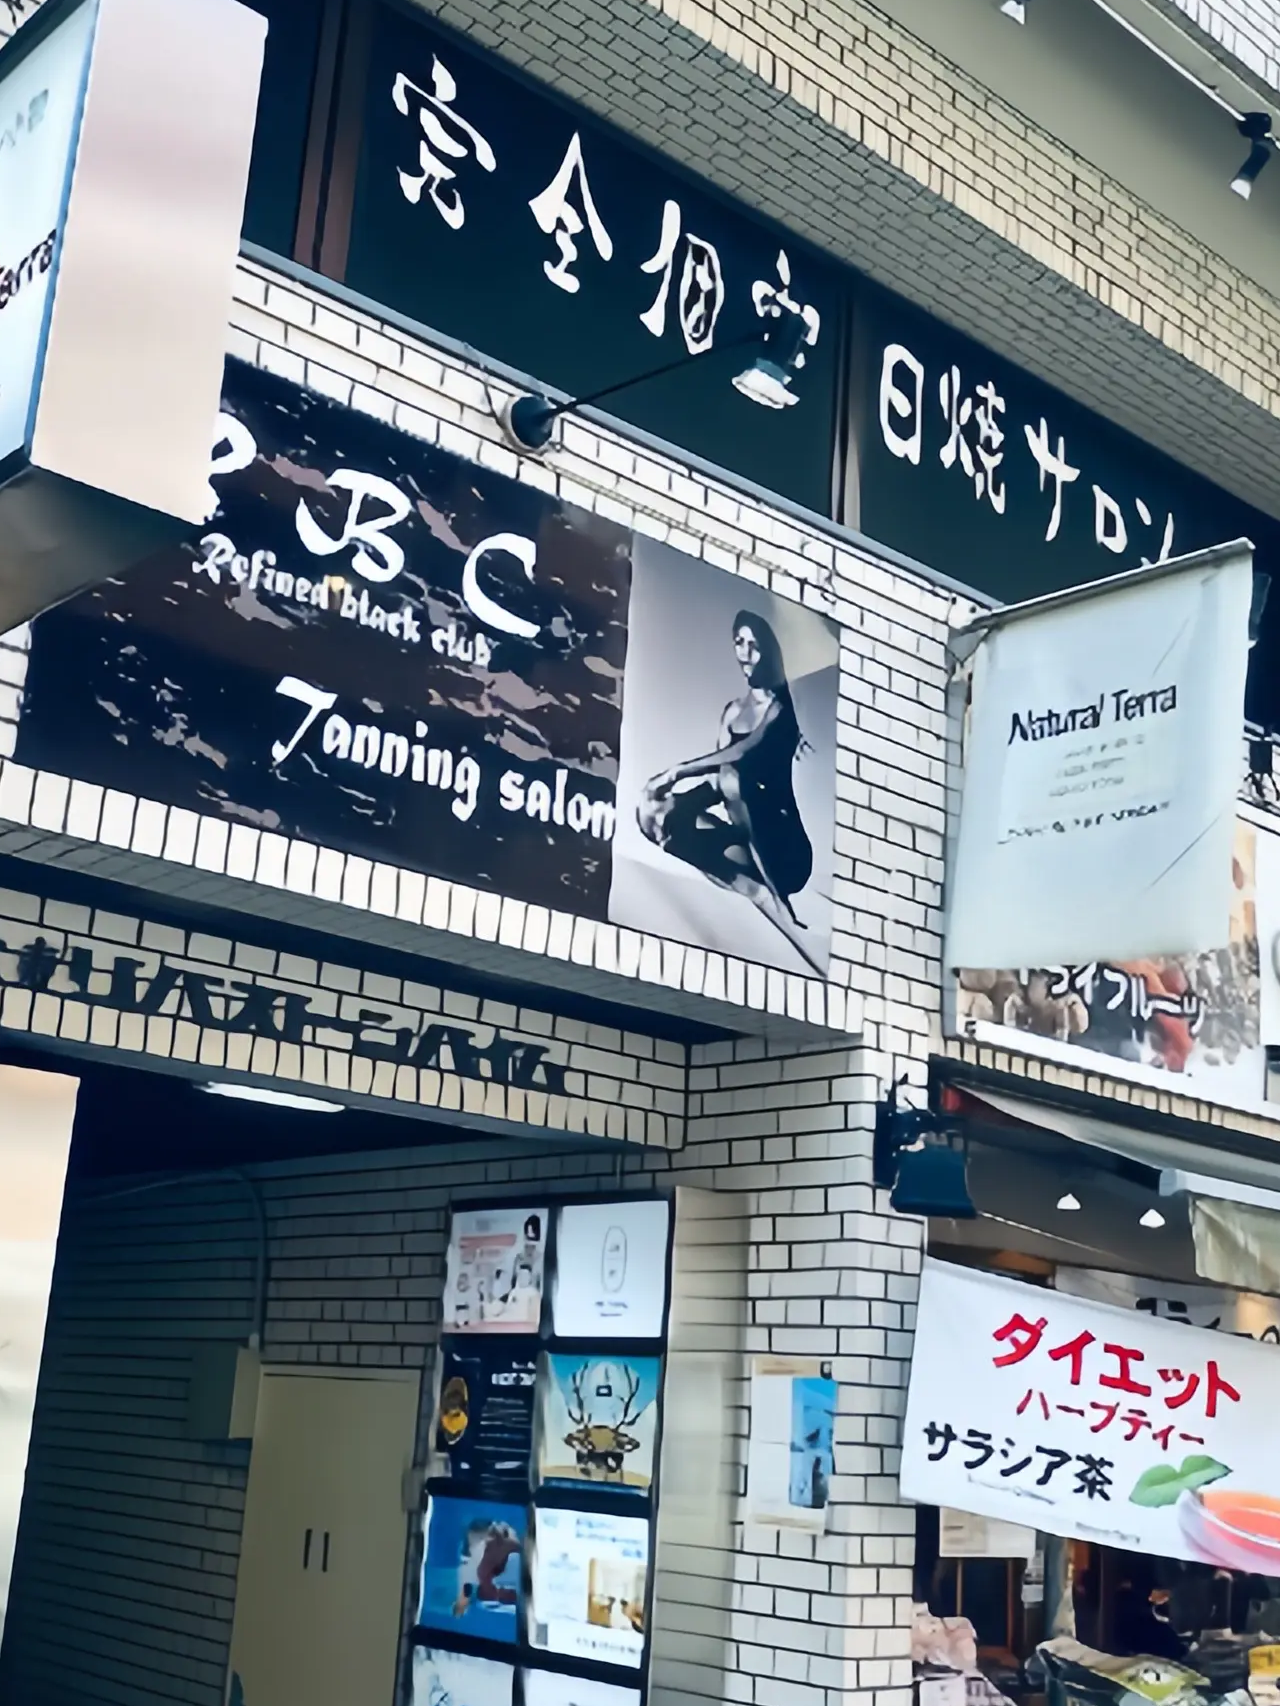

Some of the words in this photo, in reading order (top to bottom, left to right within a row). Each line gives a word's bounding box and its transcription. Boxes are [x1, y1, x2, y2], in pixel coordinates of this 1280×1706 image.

[192, 532, 329, 609] Refined
[339, 583, 421, 643] black
[431, 618, 493, 666] club
[271, 676, 480, 821] Tanning
[499, 768, 616, 841] salon
[1007, 695, 1102, 747] Natural
[1111, 683, 1178, 722] Terra
[991, 1312, 1242, 1419] ダイエット
[923, 1420, 1115, 1502] サラシア茶
